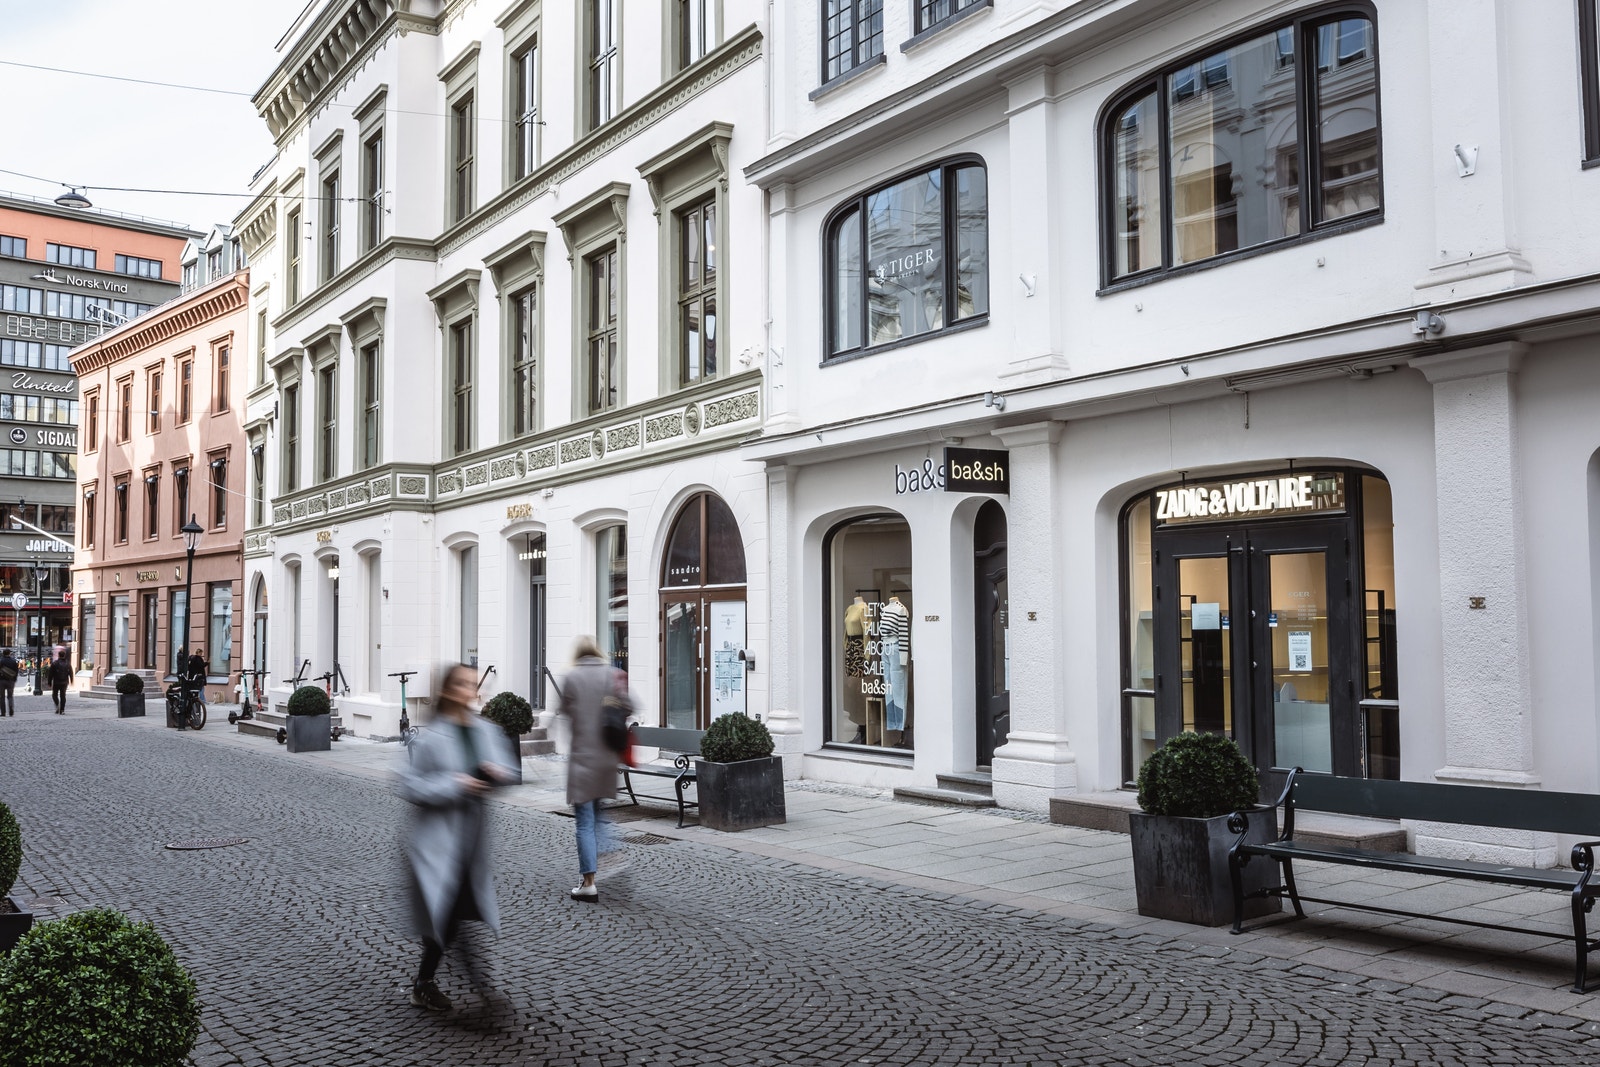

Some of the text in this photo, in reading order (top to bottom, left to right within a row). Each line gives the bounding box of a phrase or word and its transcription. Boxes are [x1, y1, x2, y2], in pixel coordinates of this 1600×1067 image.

[889, 248, 934, 275] TIGER
[66, 275, 128, 294] Norsk Vind
[12, 372, 75, 393] United
[37, 430, 78, 447] SIGDAL
[895, 458, 945, 494] ba&s
[951, 460, 1004, 482] ba&sh
[1156, 475, 1313, 519] ZADIG&VOLTAIRE
[25, 539, 67, 553] JAIPUR
[518, 548, 547, 561] sandro
[671, 565, 700, 575] sandro
[863, 641, 895, 656] ABOUT
[863, 660, 885, 676] SALE
[861, 678, 893, 695] ba&sh
